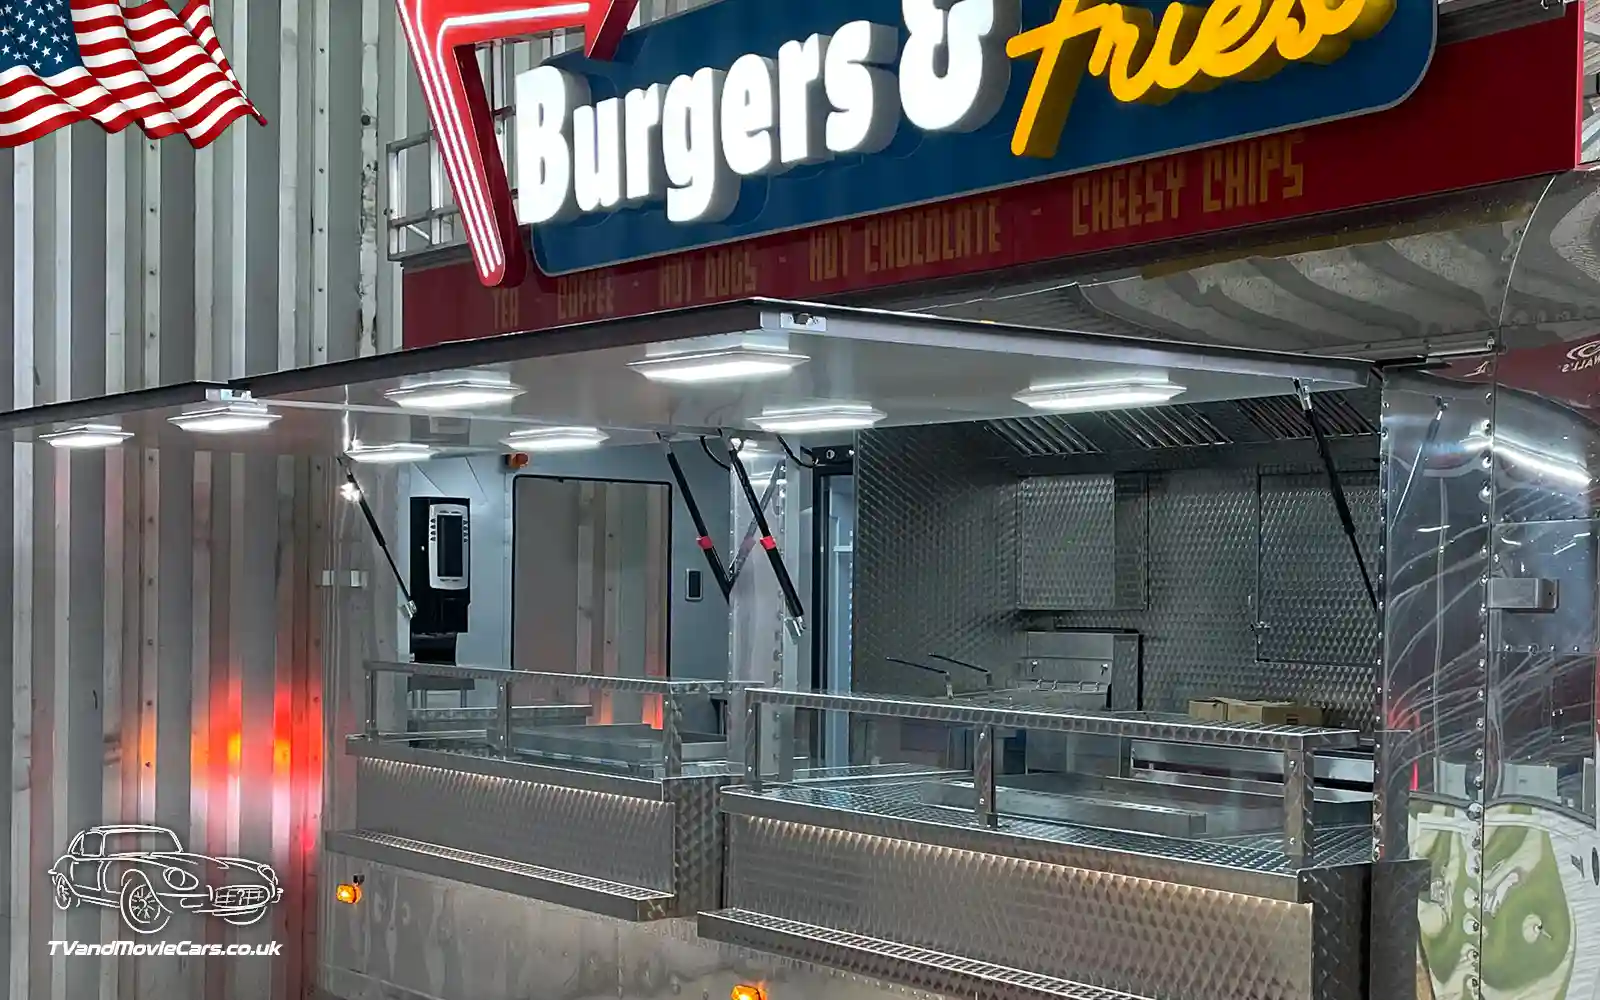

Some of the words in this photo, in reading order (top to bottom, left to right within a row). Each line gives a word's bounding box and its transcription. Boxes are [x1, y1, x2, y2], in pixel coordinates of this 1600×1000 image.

[516, 20, 876, 226] Burgers
[659, 256, 692, 306] HOT
[704, 246, 757, 297] DOGS
[809, 223, 851, 282] HOT
[864, 197, 1002, 272] CHOCOLATE
[1072, 156, 1186, 237] CHEESY
[1203, 134, 1304, 213] CHIPS
